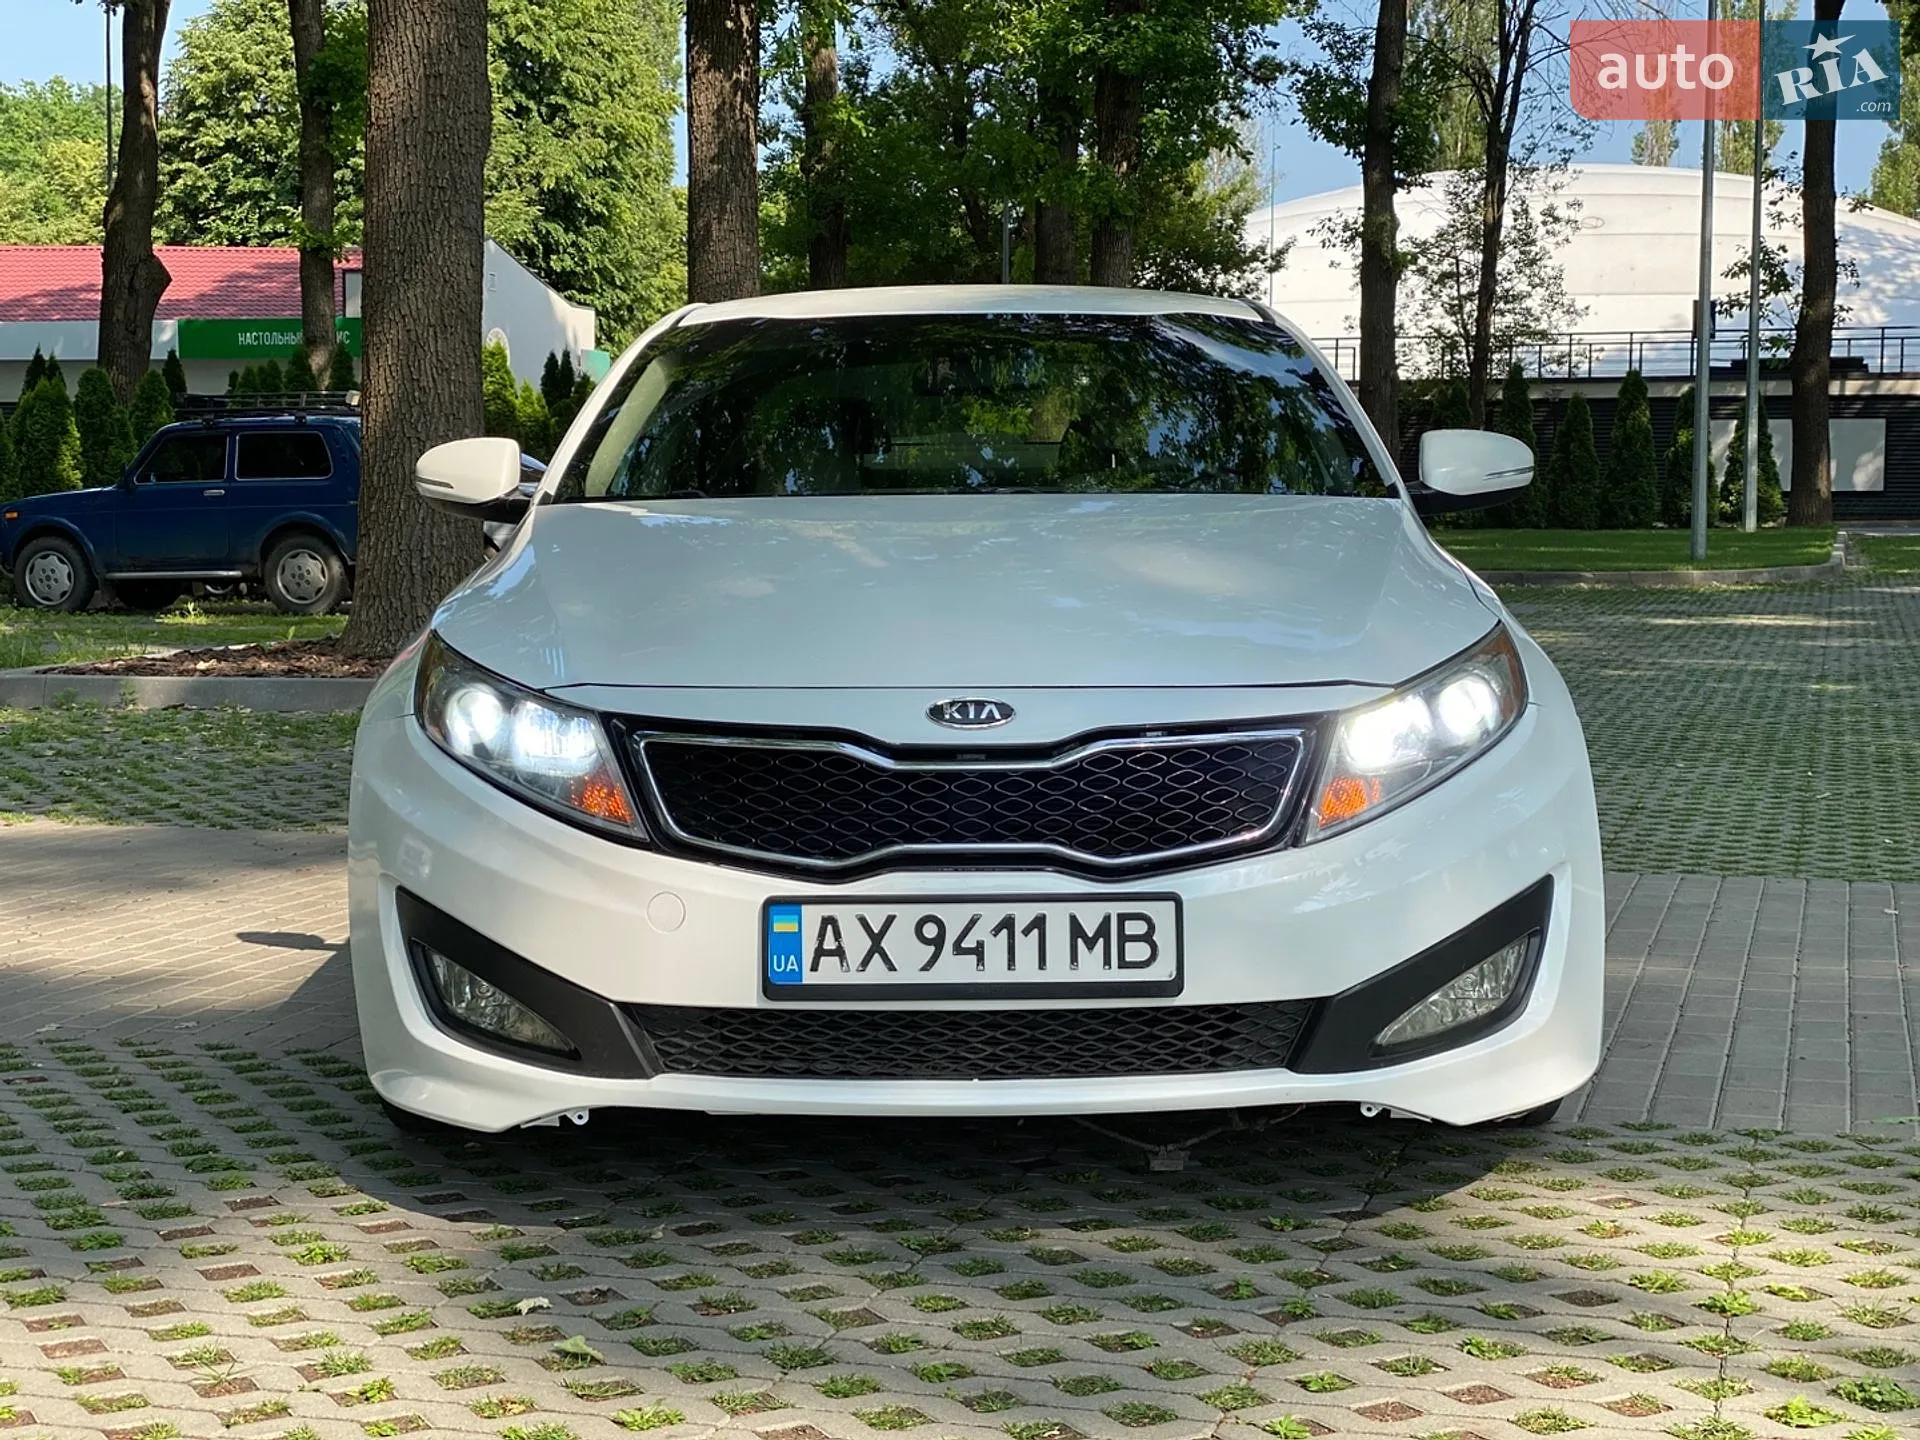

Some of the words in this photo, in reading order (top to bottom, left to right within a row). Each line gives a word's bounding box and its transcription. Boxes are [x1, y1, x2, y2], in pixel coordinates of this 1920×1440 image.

[942, 702, 1002, 720] KIA
[809, 913, 899, 972] AX
[914, 913, 1047, 972] 9411
[1069, 911, 1160, 971] MB
[773, 954, 799, 972] UA
